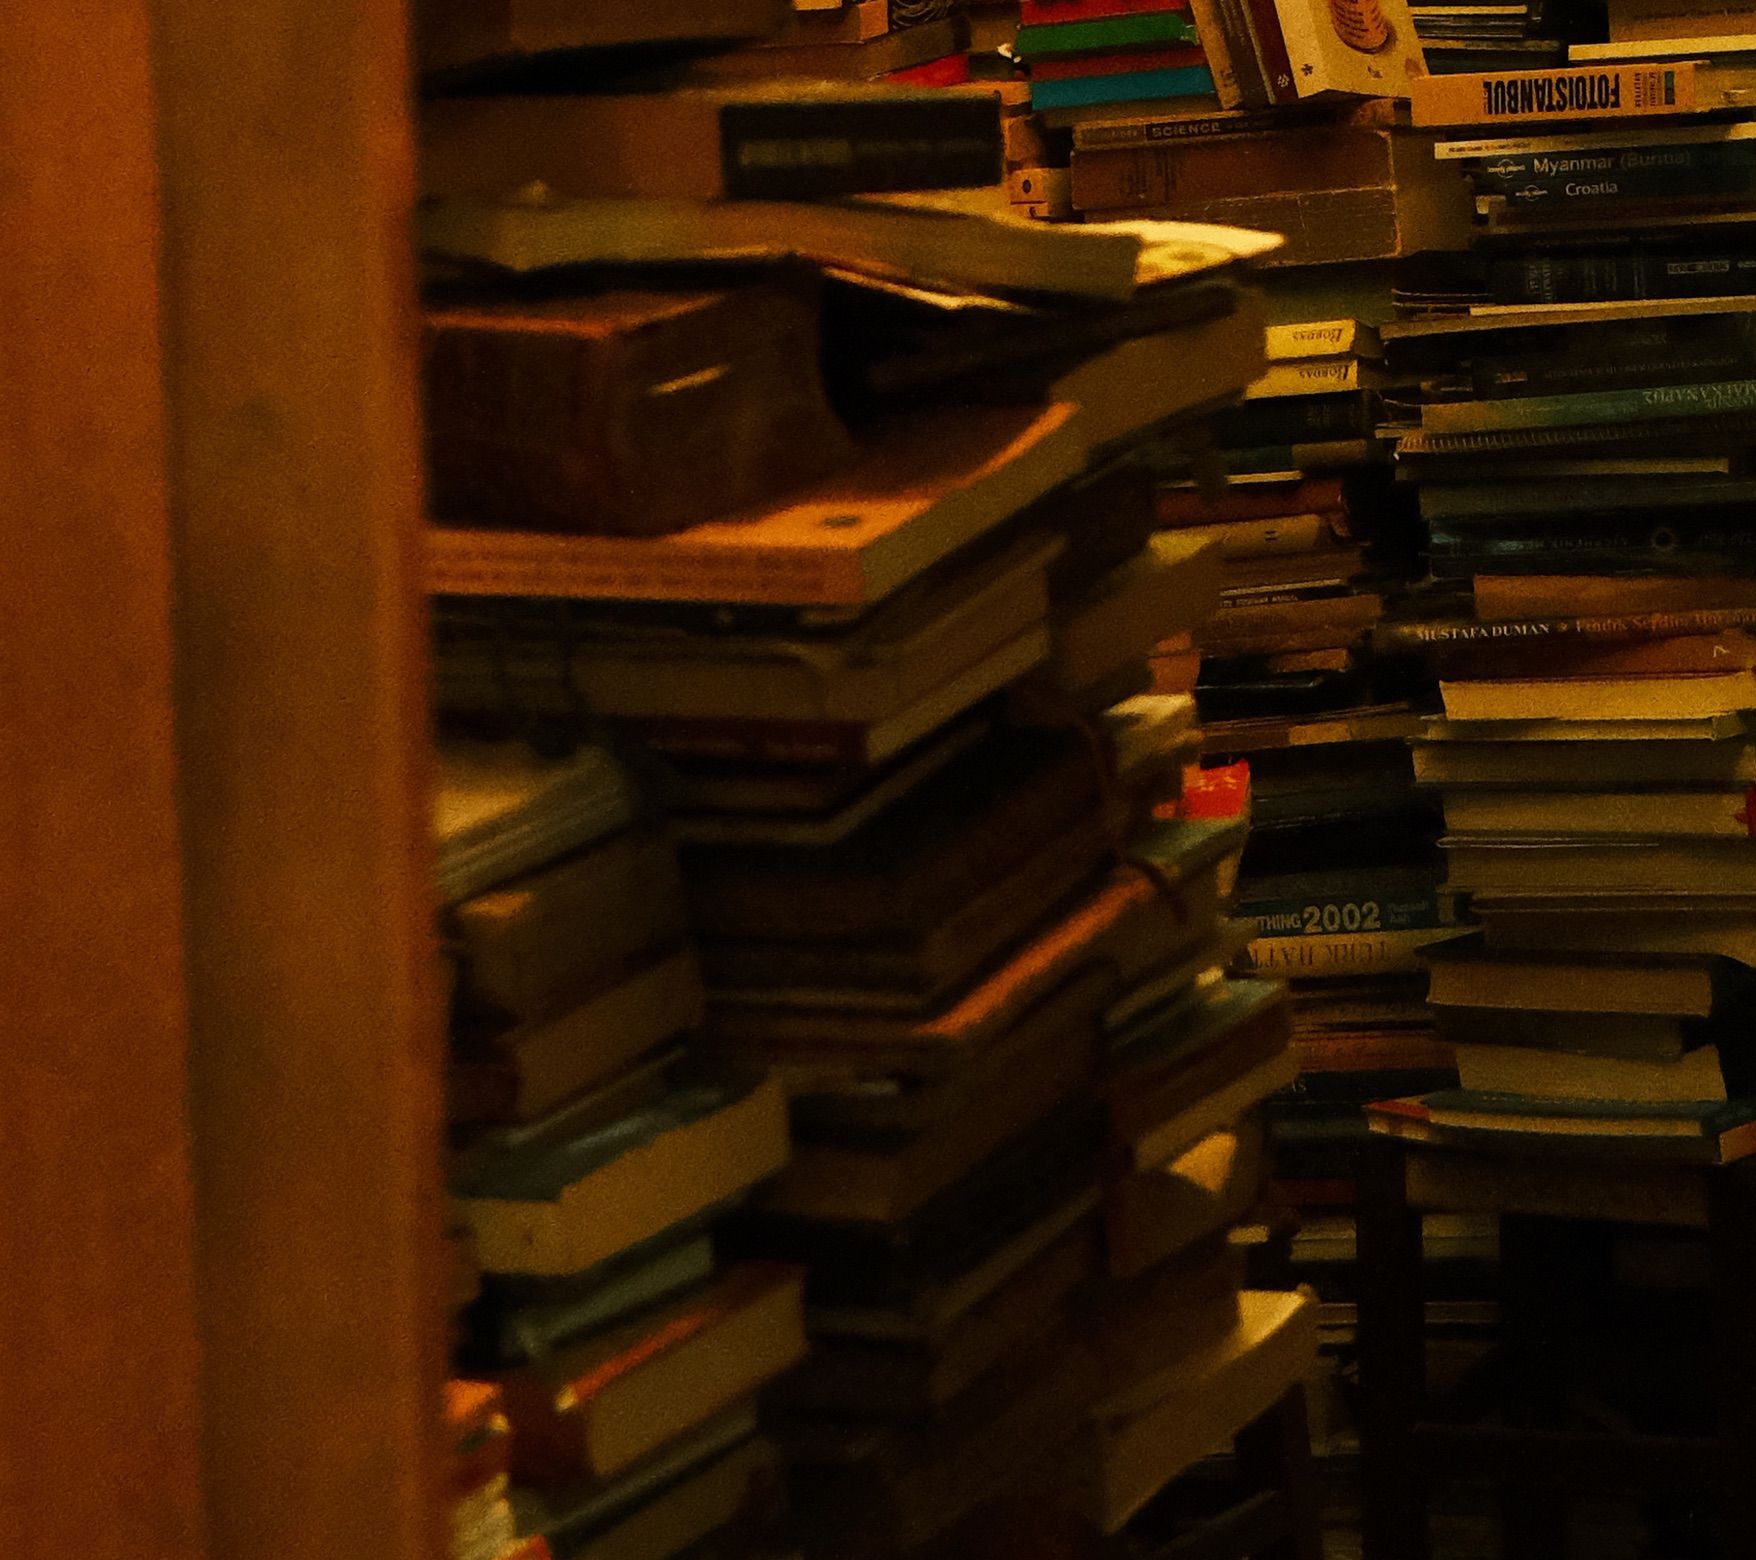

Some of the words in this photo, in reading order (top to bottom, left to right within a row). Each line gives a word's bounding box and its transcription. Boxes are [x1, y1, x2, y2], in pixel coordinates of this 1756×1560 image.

[1151, 121, 1222, 139] SCIENCE
[1532, 152, 1615, 174] Myanmar
[1564, 179, 1619, 198] Croatia
[1302, 900, 1383, 932] 2002
